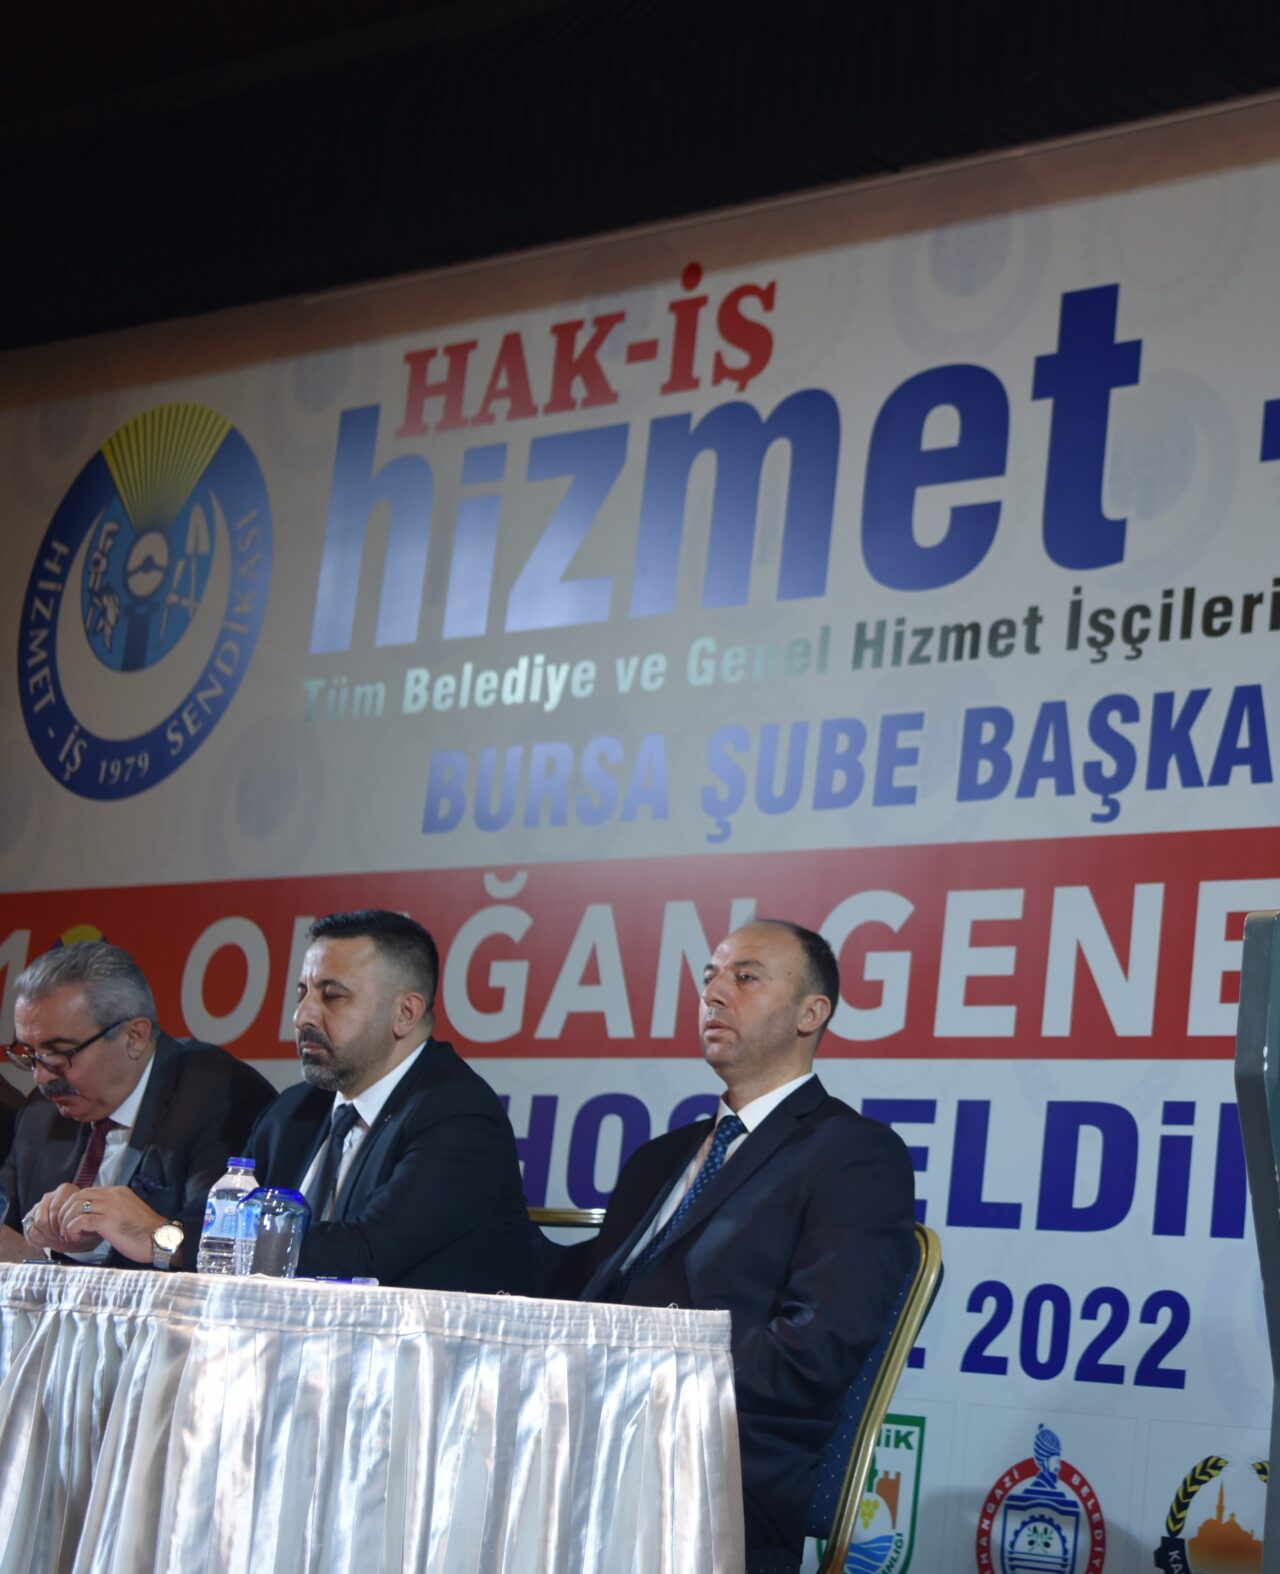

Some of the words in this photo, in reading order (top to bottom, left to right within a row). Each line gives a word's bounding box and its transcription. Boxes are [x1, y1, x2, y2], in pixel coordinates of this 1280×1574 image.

[395, 261, 776, 440] HAK-İŞ
[309, 283, 1142, 654] hizmet
[302, 676, 386, 723] Tüm
[402, 653, 597, 715] Belediye
[615, 651, 668, 694] ve
[686, 623, 831, 688] Genel
[850, 605, 1044, 671] Hizmet
[98, 752, 149, 785] 1979
[422, 732, 671, 836] BURSA
[700, 711, 925, 844] ŞUBE
[180, 870, 757, 1045] OĞAN
[959, 1279, 1192, 1390] 2022
